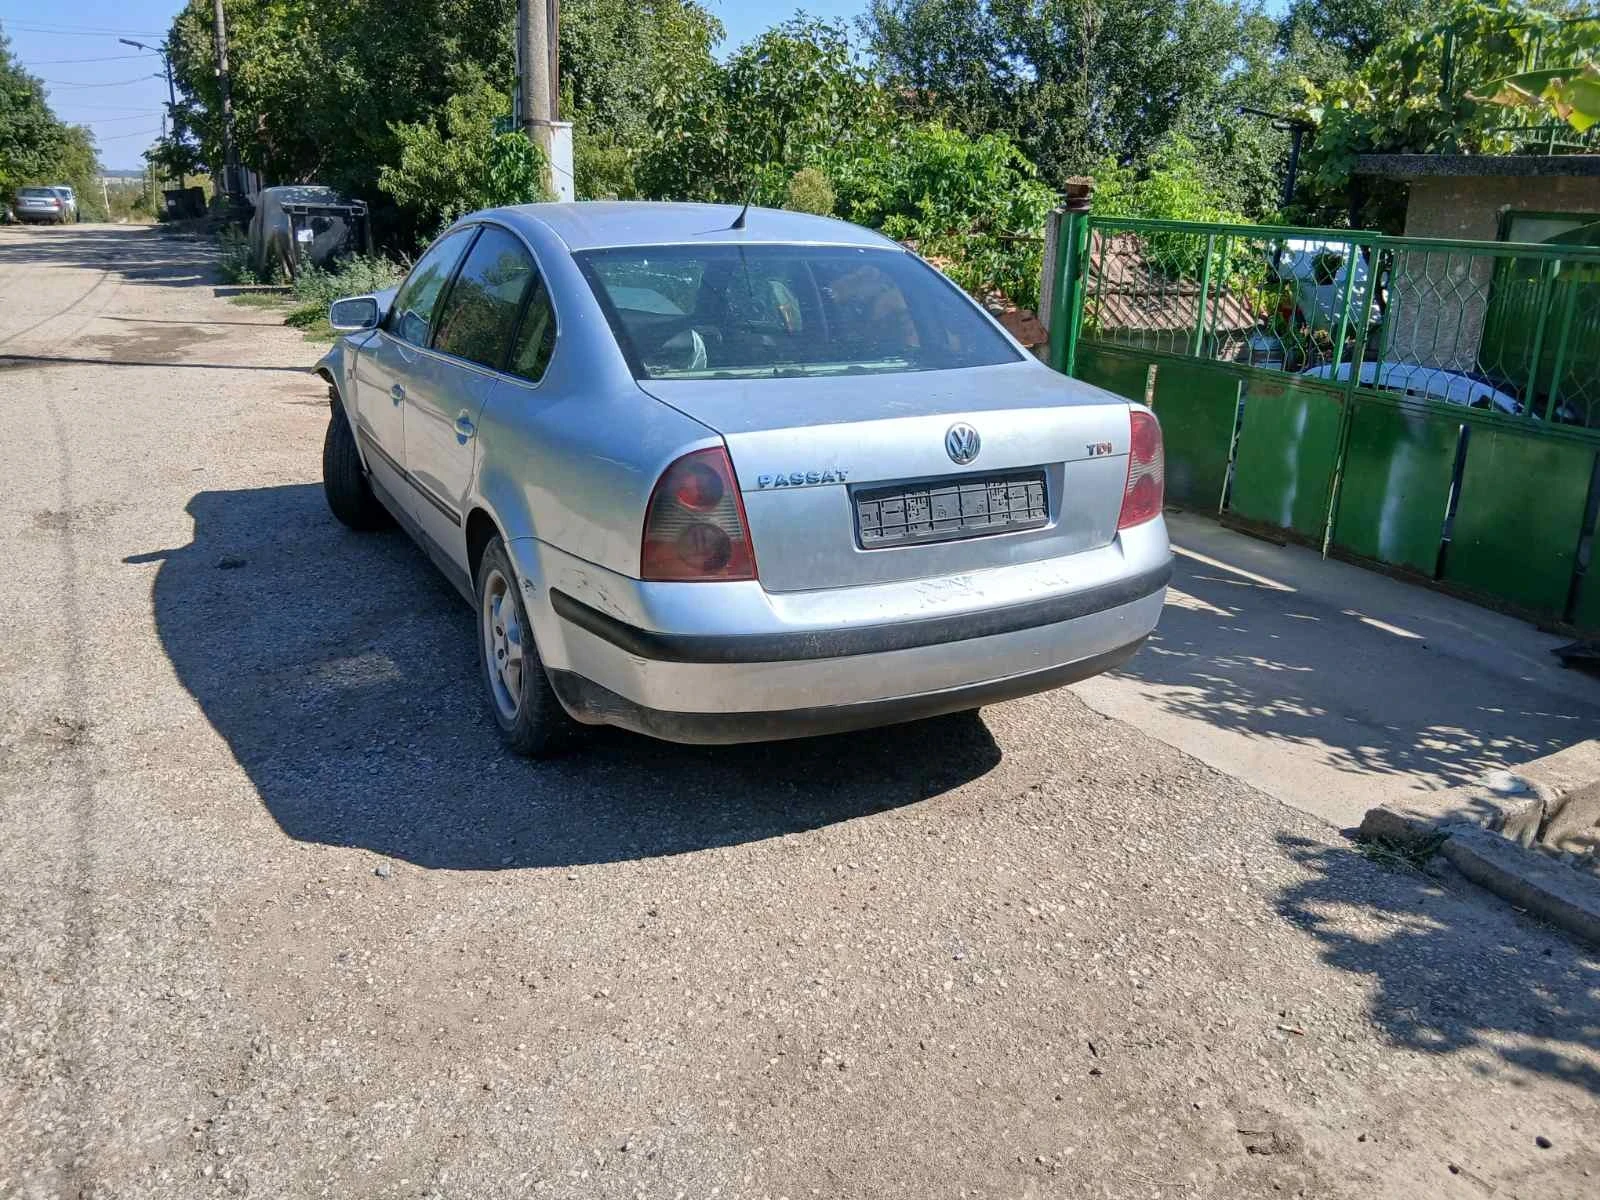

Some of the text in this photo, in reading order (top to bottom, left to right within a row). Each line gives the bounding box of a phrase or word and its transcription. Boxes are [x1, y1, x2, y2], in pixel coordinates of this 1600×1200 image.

[947, 424, 980, 463] VW
[1086, 442, 1112, 456] TDI
[758, 470, 848, 488] PASSAT
